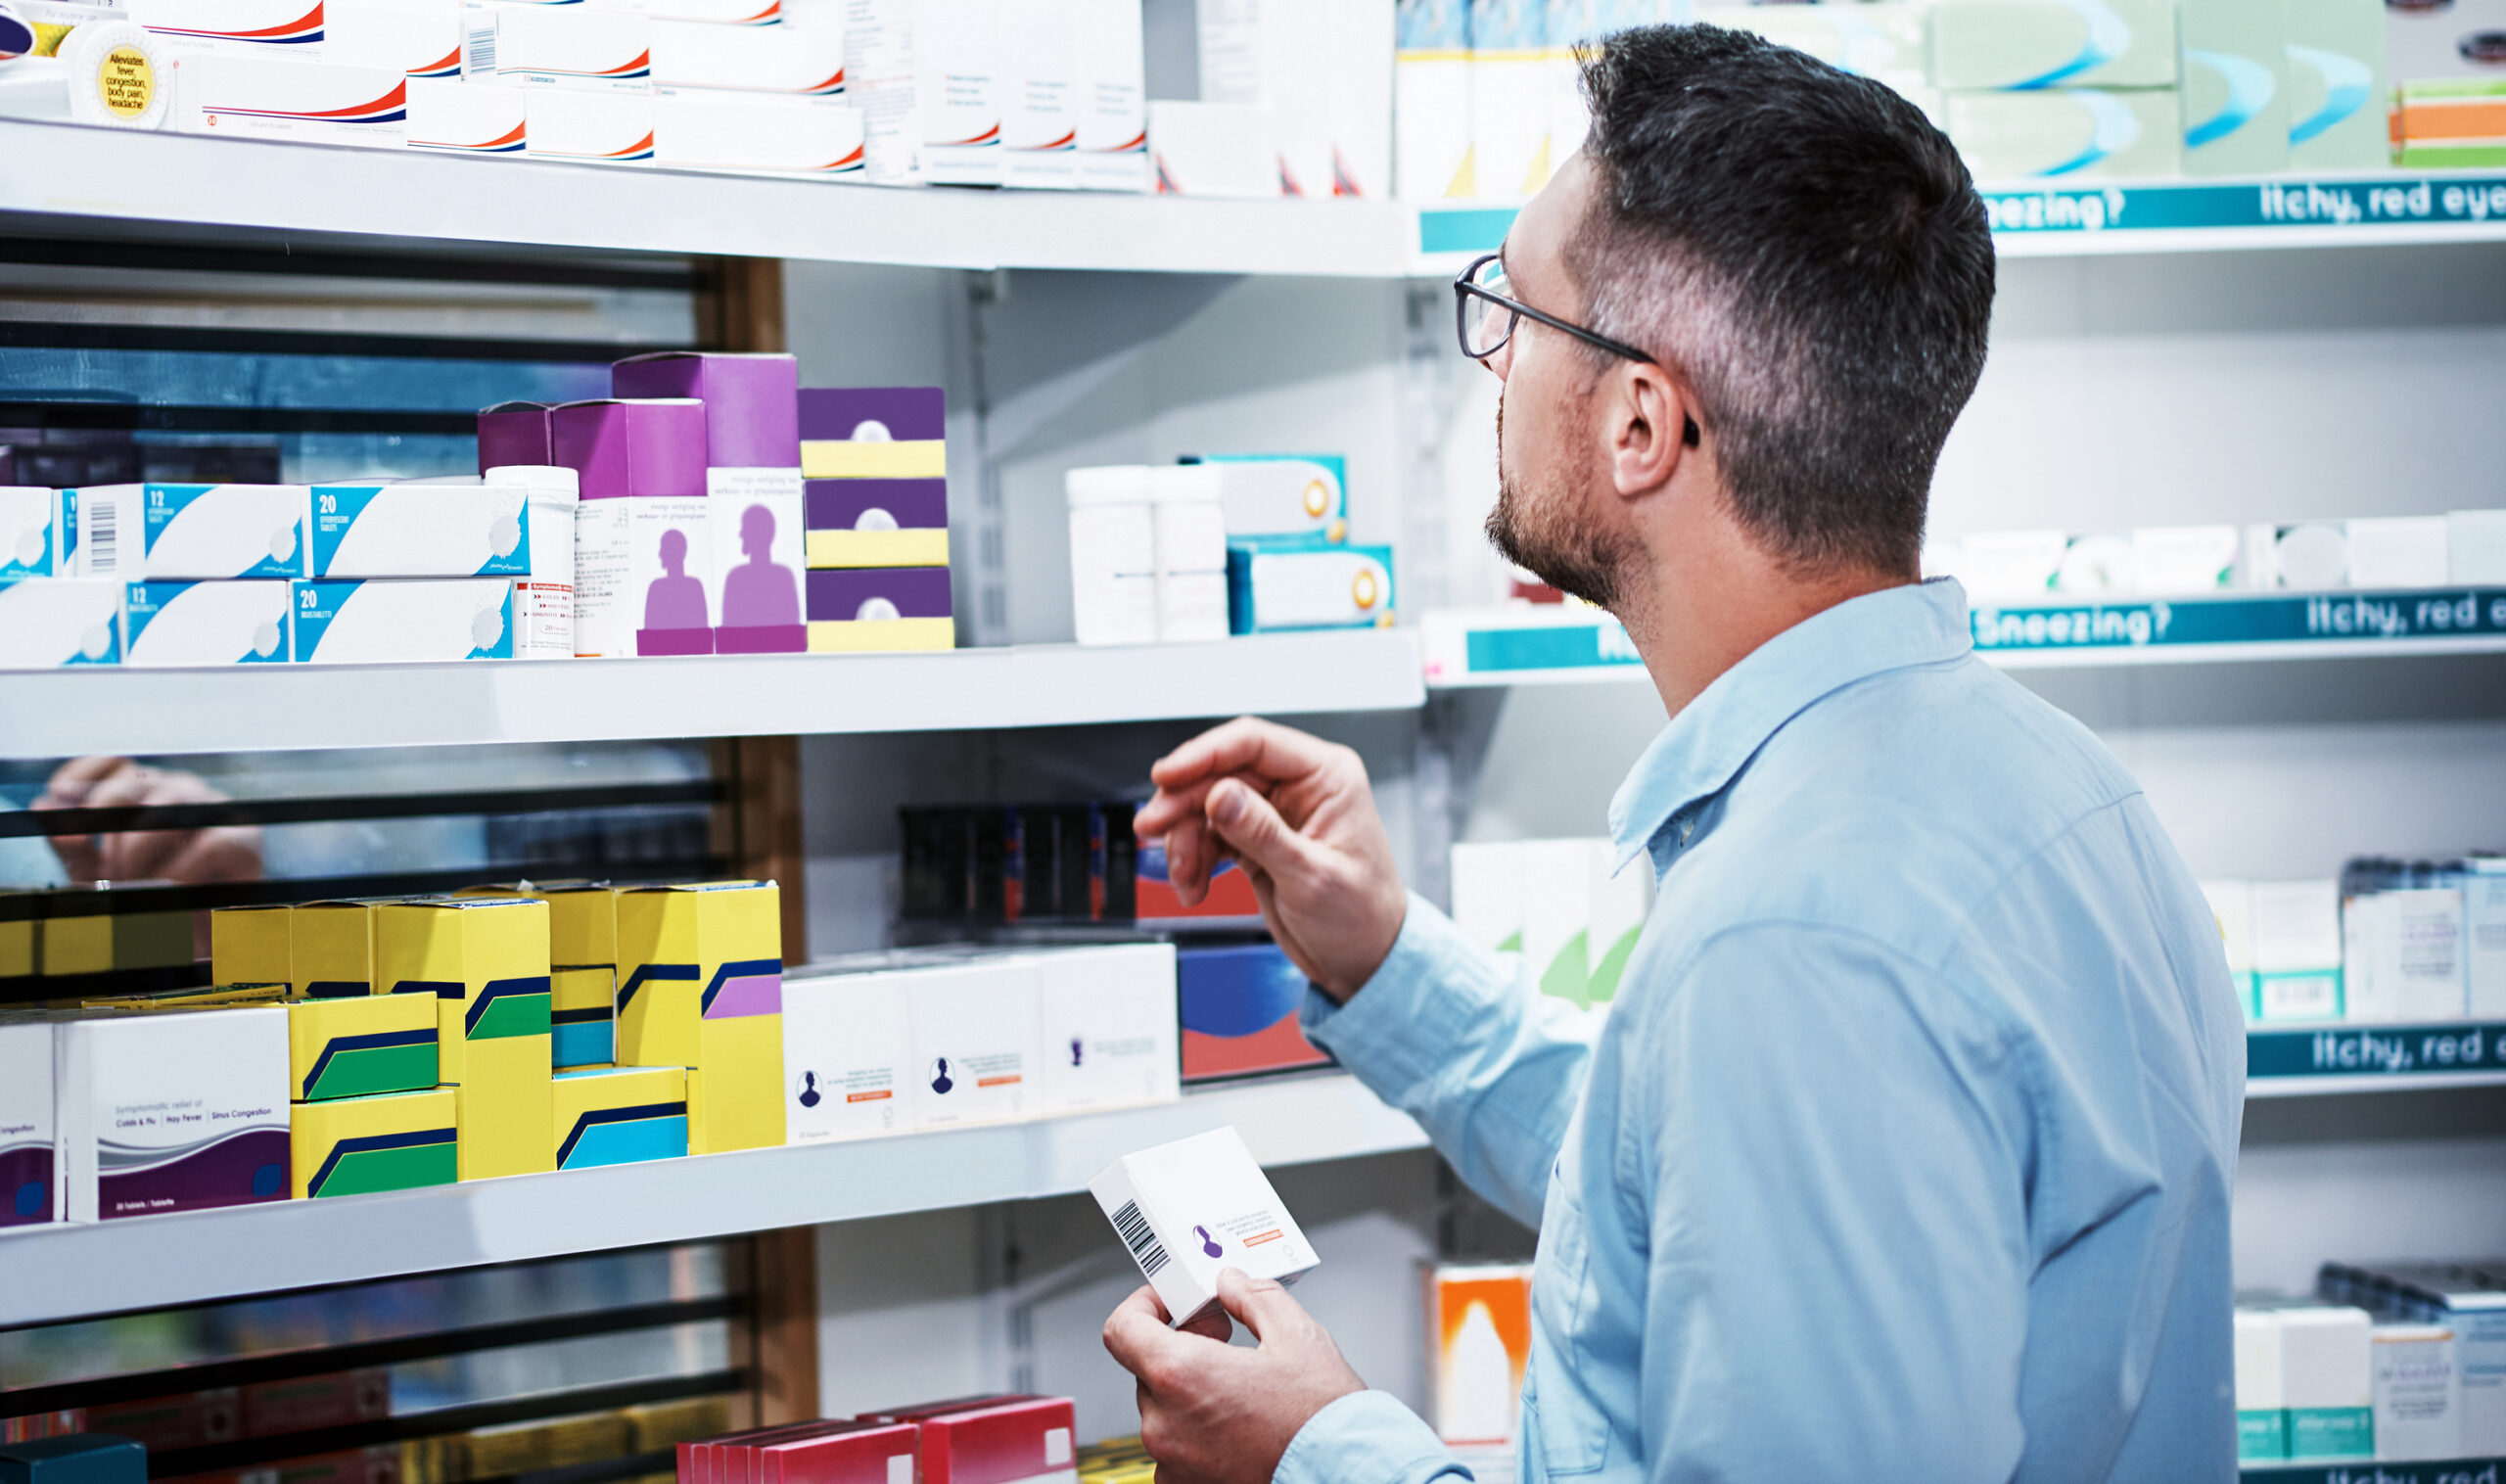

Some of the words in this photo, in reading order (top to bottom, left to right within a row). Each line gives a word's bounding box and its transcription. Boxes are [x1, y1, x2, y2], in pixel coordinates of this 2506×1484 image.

[110, 54, 144, 67] Alleviates
[117, 66, 136, 78] fever,
[106, 77, 146, 89] congestion,
[108, 86, 124, 98] body
[127, 89, 144, 101] pain,
[108, 97, 143, 109] headache
[2260, 183, 2362, 223] Itchy,
[2369, 180, 2431, 217] red
[151, 490, 164, 506] 12
[319, 494, 337, 514] 20
[132, 587, 147, 604] 12
[301, 589, 317, 609] 20
[2307, 595, 2407, 636] Itchy,
[2416, 590, 2478, 630] red
[1975, 603, 2172, 647] Sneezing?
[2313, 1032, 2413, 1073] Itchy,
[2422, 1027, 2482, 1064] red
[116, 1102, 168, 1115] Symptomatic
[172, 1099, 193, 1110] relief
[166, 1116, 180, 1125] Hay
[182, 1113, 203, 1122] Fever
[211, 1110, 230, 1120] Sinus
[232, 1107, 272, 1119] Congestion
